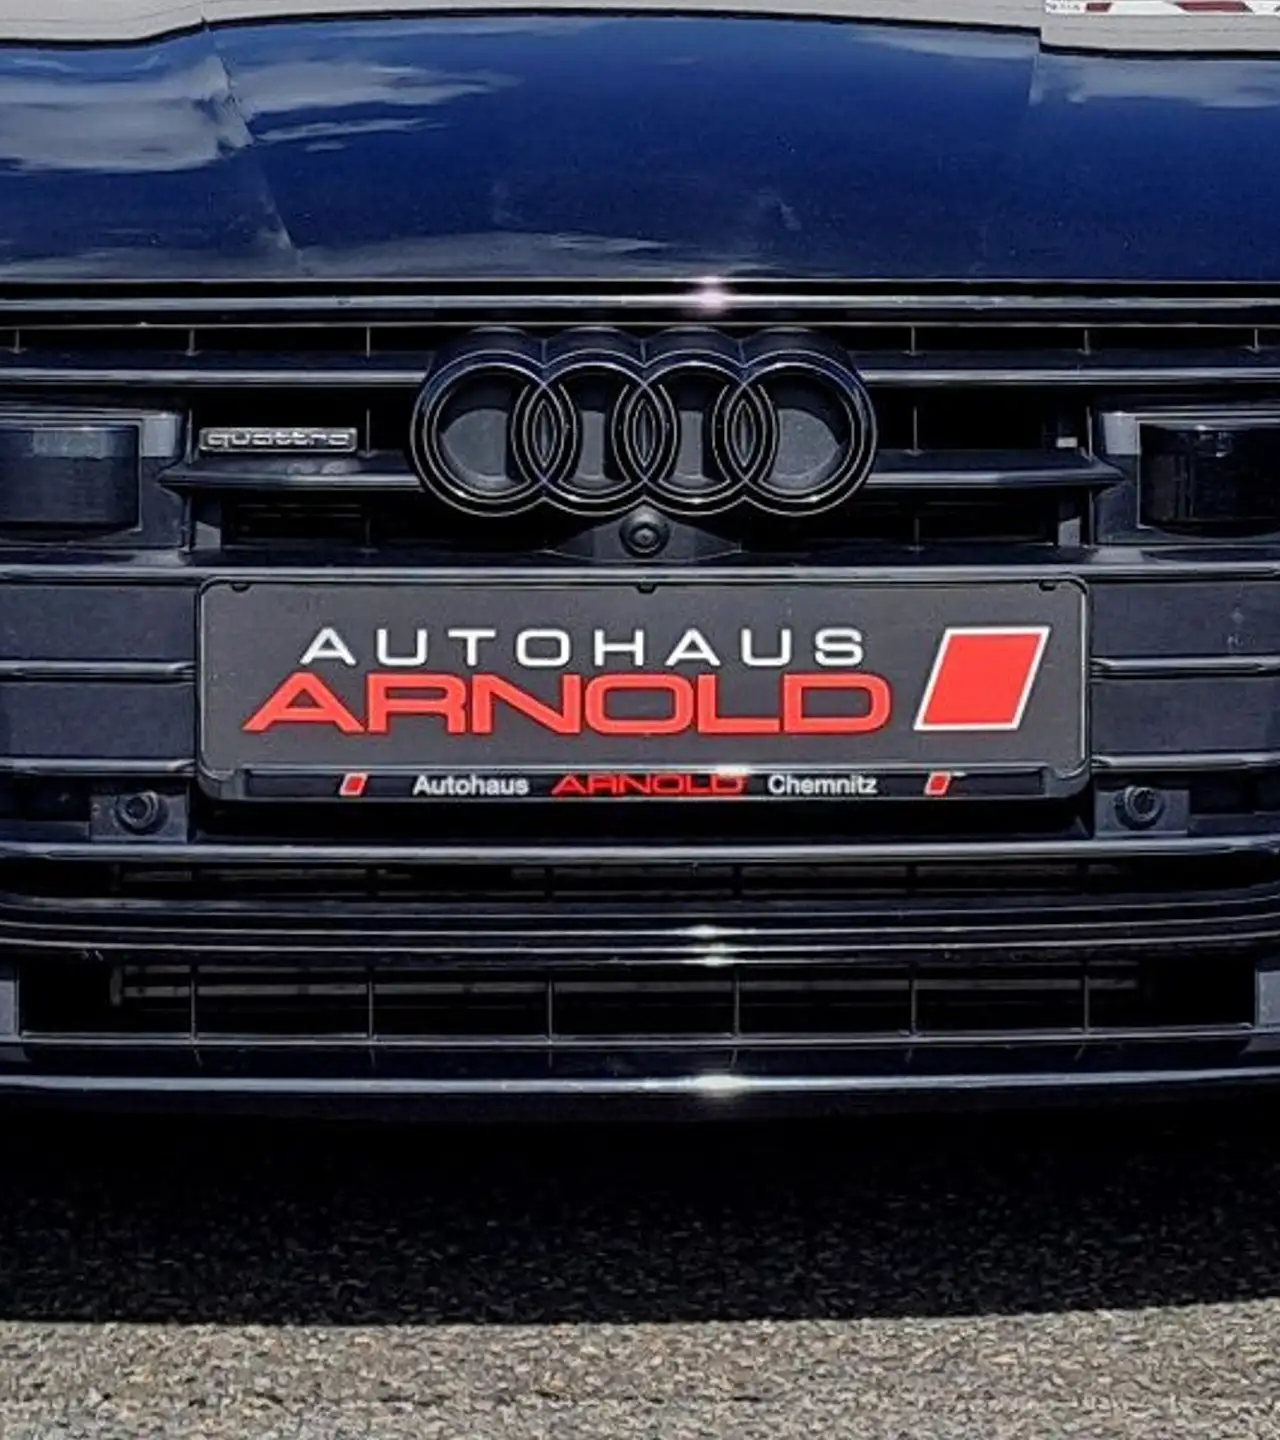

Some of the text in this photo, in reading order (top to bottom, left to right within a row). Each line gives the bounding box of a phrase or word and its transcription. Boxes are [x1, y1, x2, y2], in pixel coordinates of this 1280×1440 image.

[207, 430, 350, 448] quattro
[300, 627, 863, 667] AUTOHAUS
[242, 672, 893, 735] ARNOLD
[412, 772, 878, 796] Autohaus ARNOLD Chemnitz
